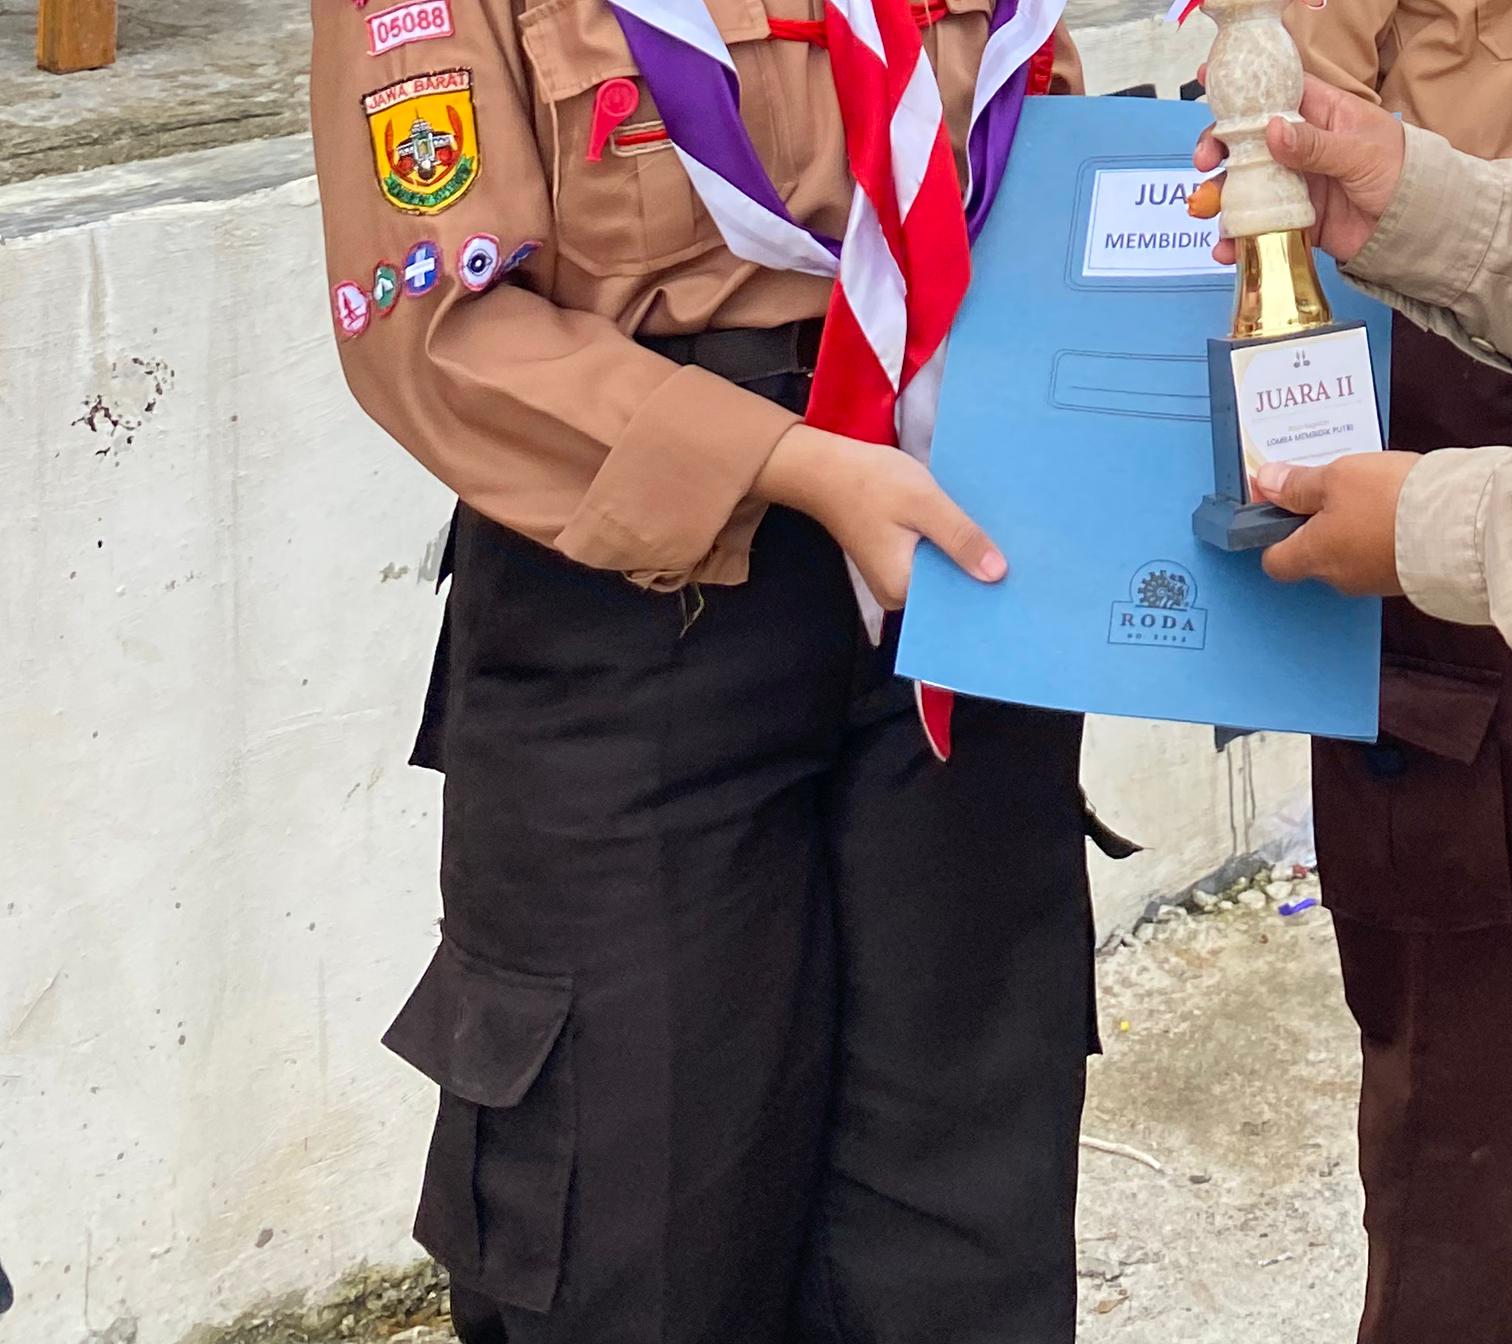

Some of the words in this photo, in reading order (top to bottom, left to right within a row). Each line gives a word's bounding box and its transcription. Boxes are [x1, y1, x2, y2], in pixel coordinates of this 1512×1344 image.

[376, 6, 446, 45] 05088
[368, 84, 409, 111] JAWA
[413, 72, 466, 94] BARAT
[1104, 231, 1213, 250] MEMBIDIK
[1255, 379, 1332, 413] JUARA
[1336, 374, 1355, 398] II
[1120, 612, 1196, 632] RODA
